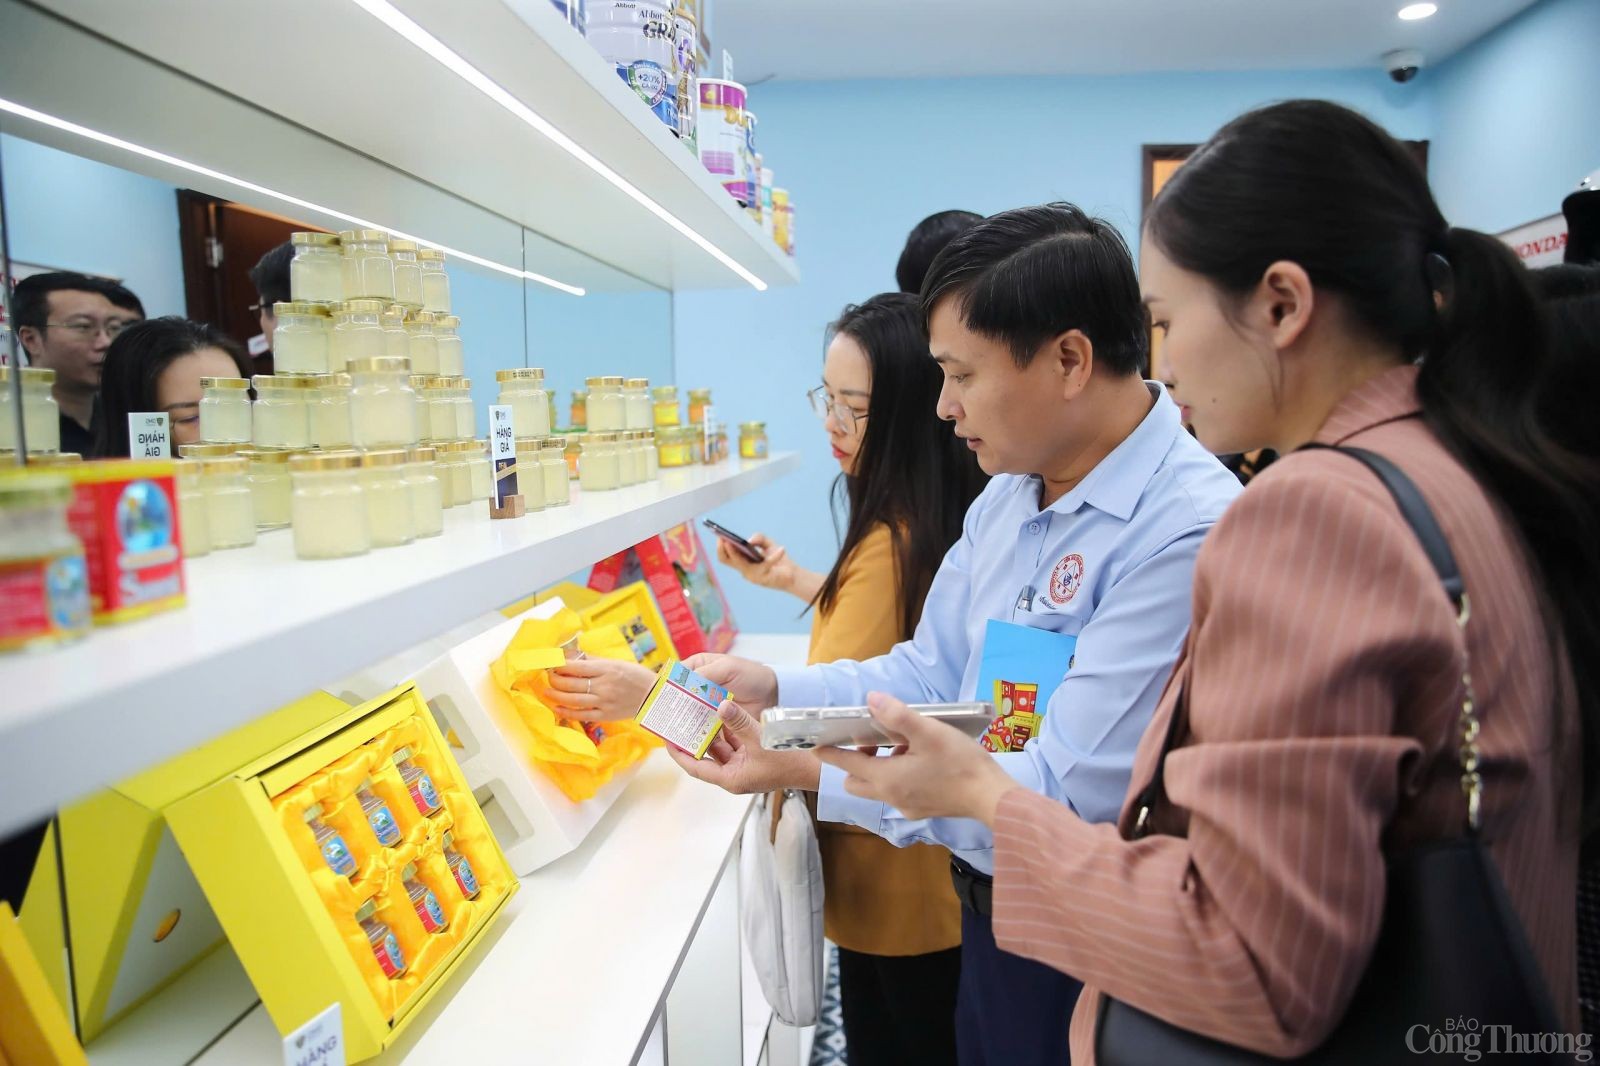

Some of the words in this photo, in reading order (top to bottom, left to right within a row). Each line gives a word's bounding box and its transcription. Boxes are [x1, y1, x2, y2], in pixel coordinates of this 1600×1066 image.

[1513, 232, 1568, 259] ONDA
[496, 425, 512, 438] HÀNG
[500, 438, 510, 453] GIẢ
